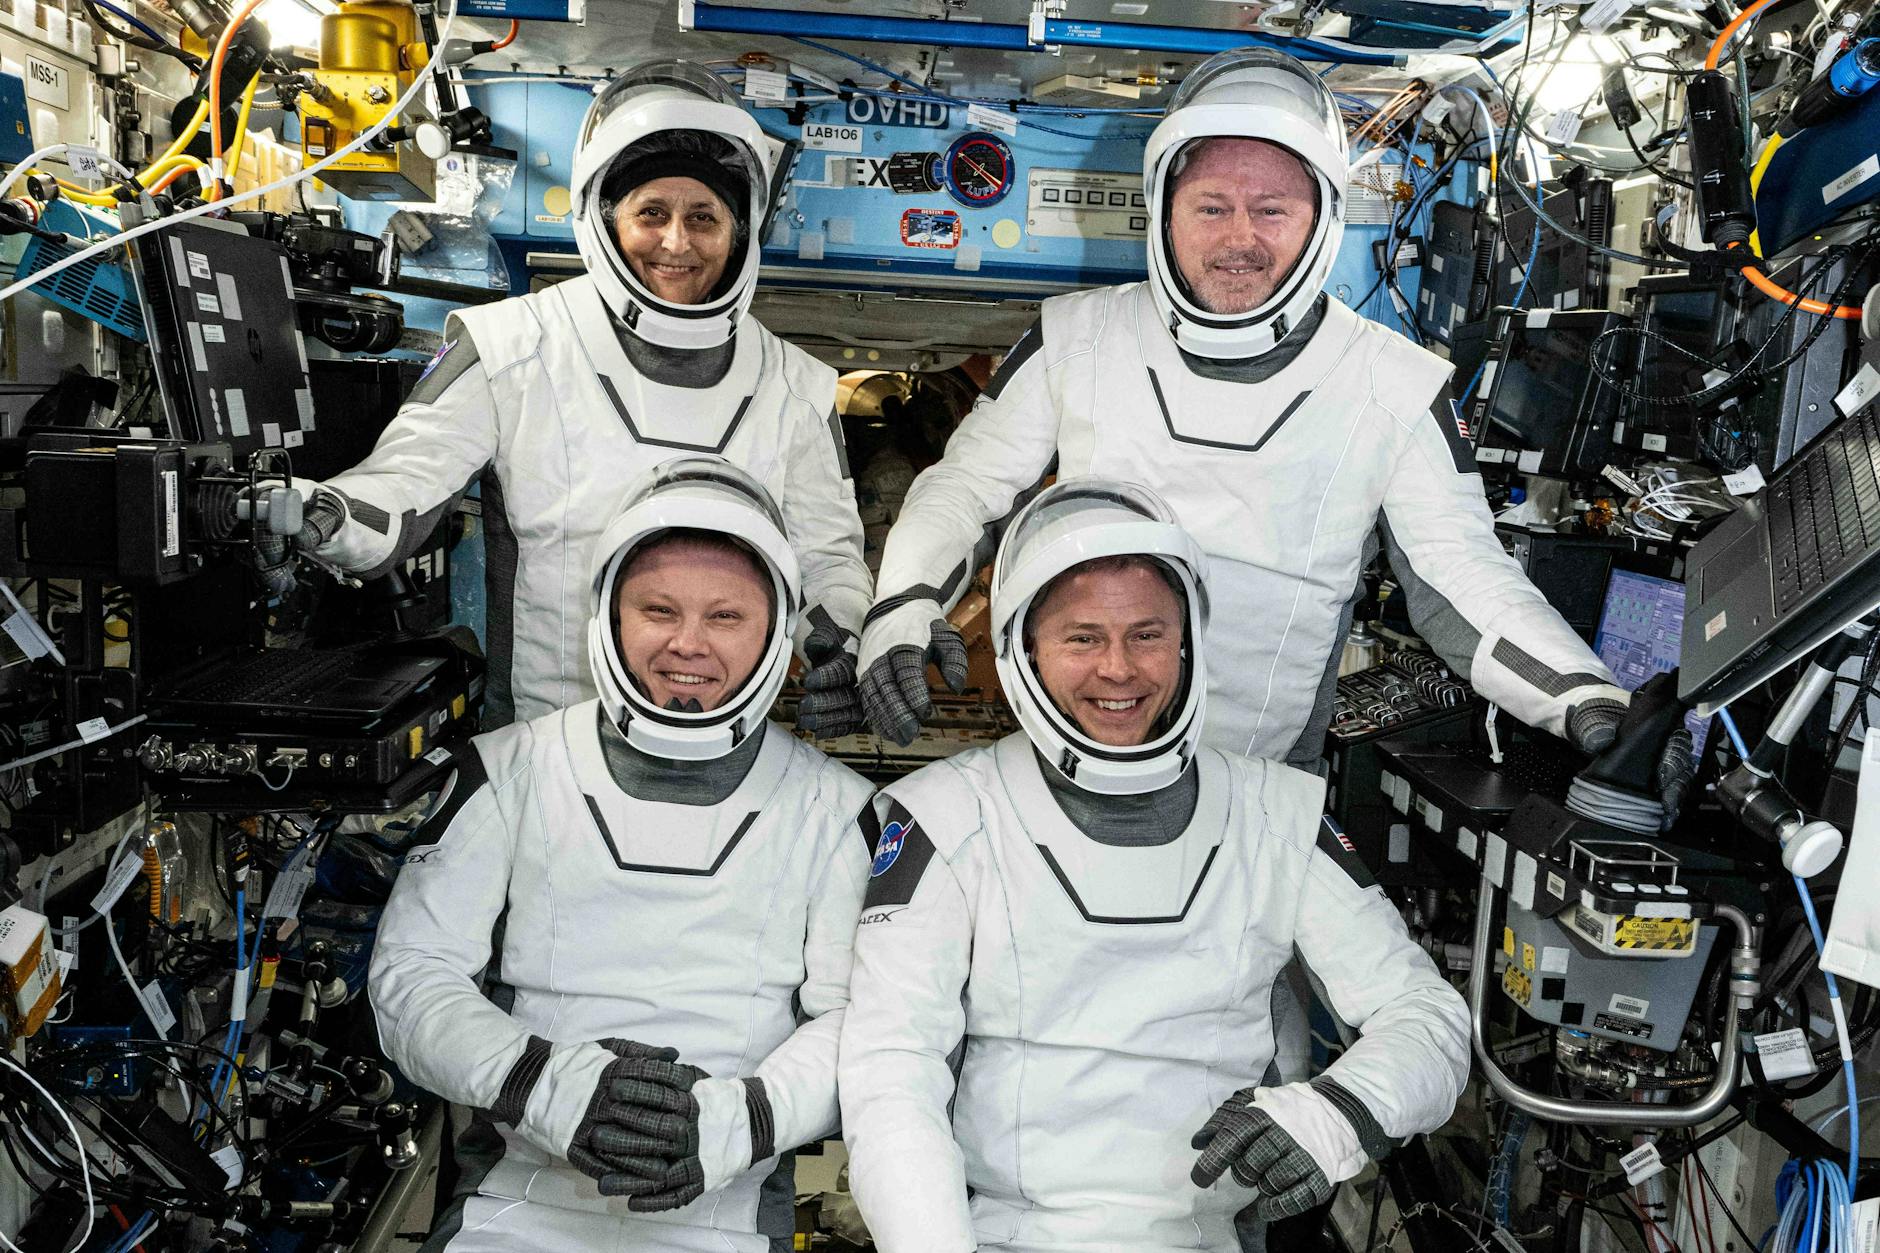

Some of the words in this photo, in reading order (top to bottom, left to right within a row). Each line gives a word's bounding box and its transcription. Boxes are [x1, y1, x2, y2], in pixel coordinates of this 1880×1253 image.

[29, 61, 58, 87] MSS-1
[848, 95, 948, 127] OVHD
[876, 842, 897, 856] NASA
